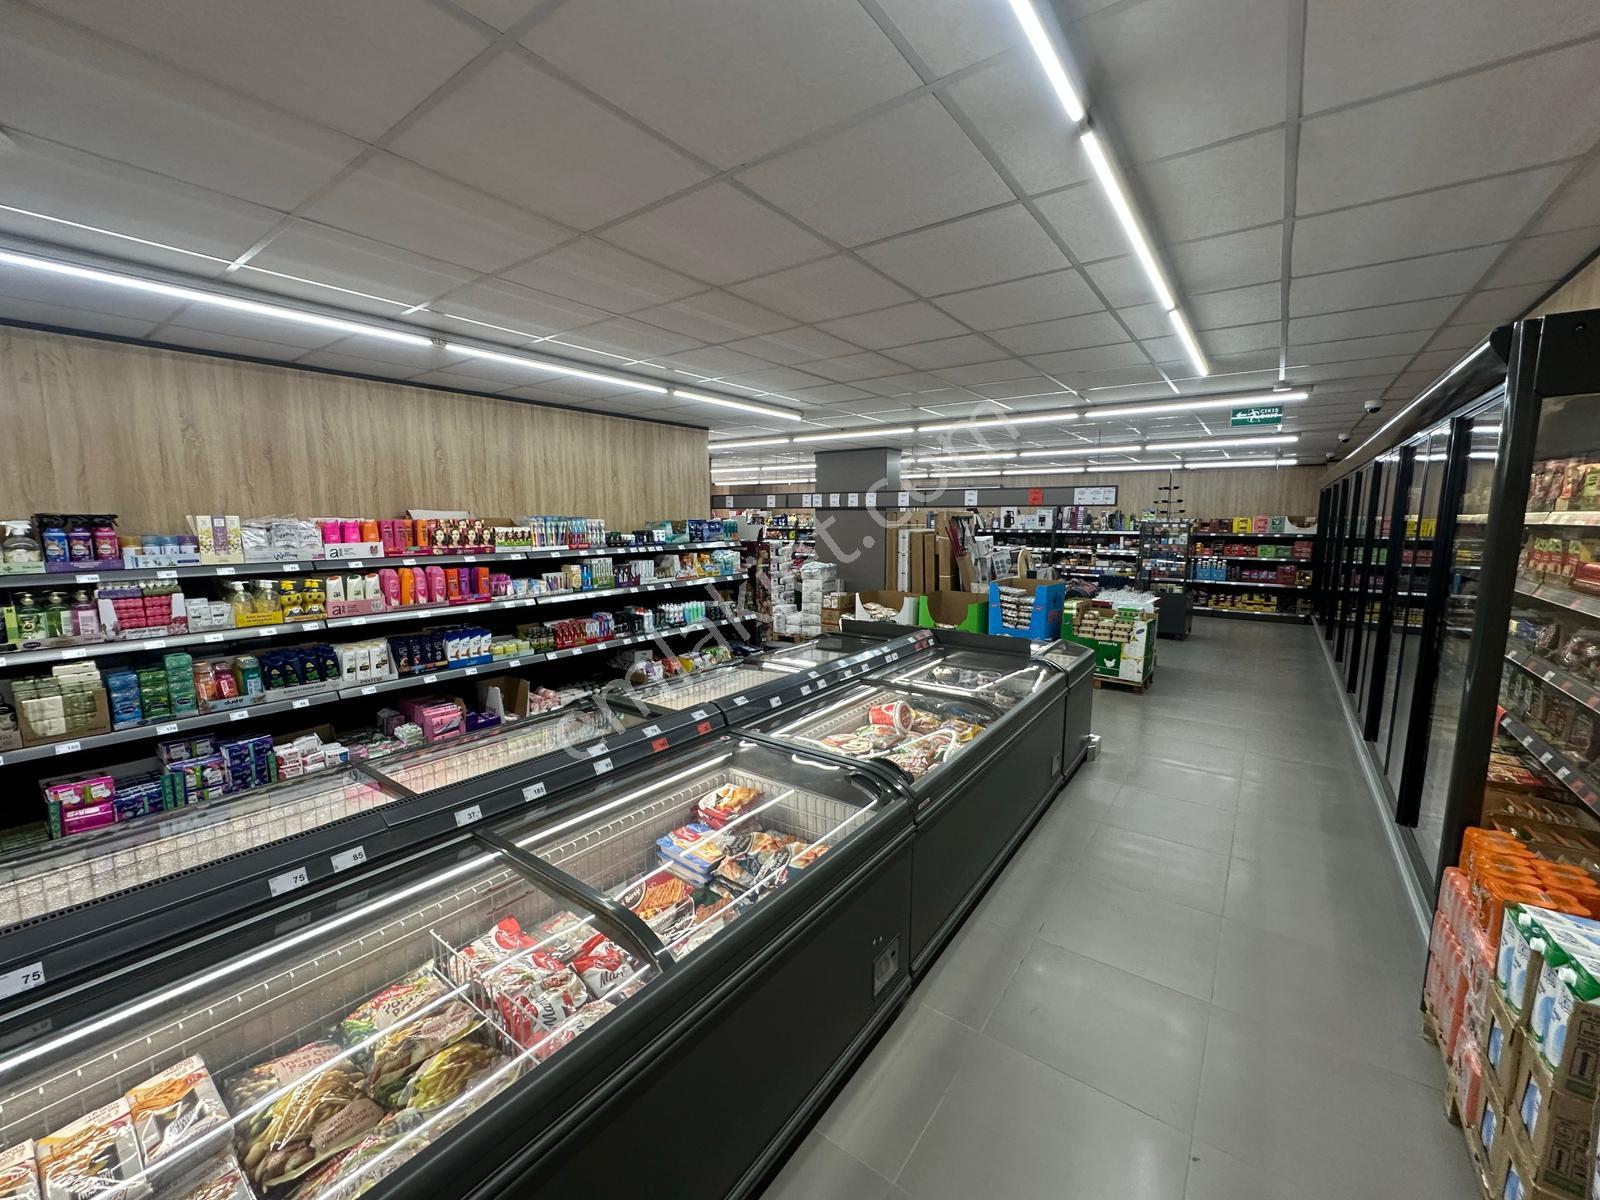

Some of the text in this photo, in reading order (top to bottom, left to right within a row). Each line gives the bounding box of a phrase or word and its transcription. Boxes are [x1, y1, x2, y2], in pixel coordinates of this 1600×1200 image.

[352, 851, 364, 861] 85
[292, 873, 305, 884] 75
[21, 970, 42, 985] 75
